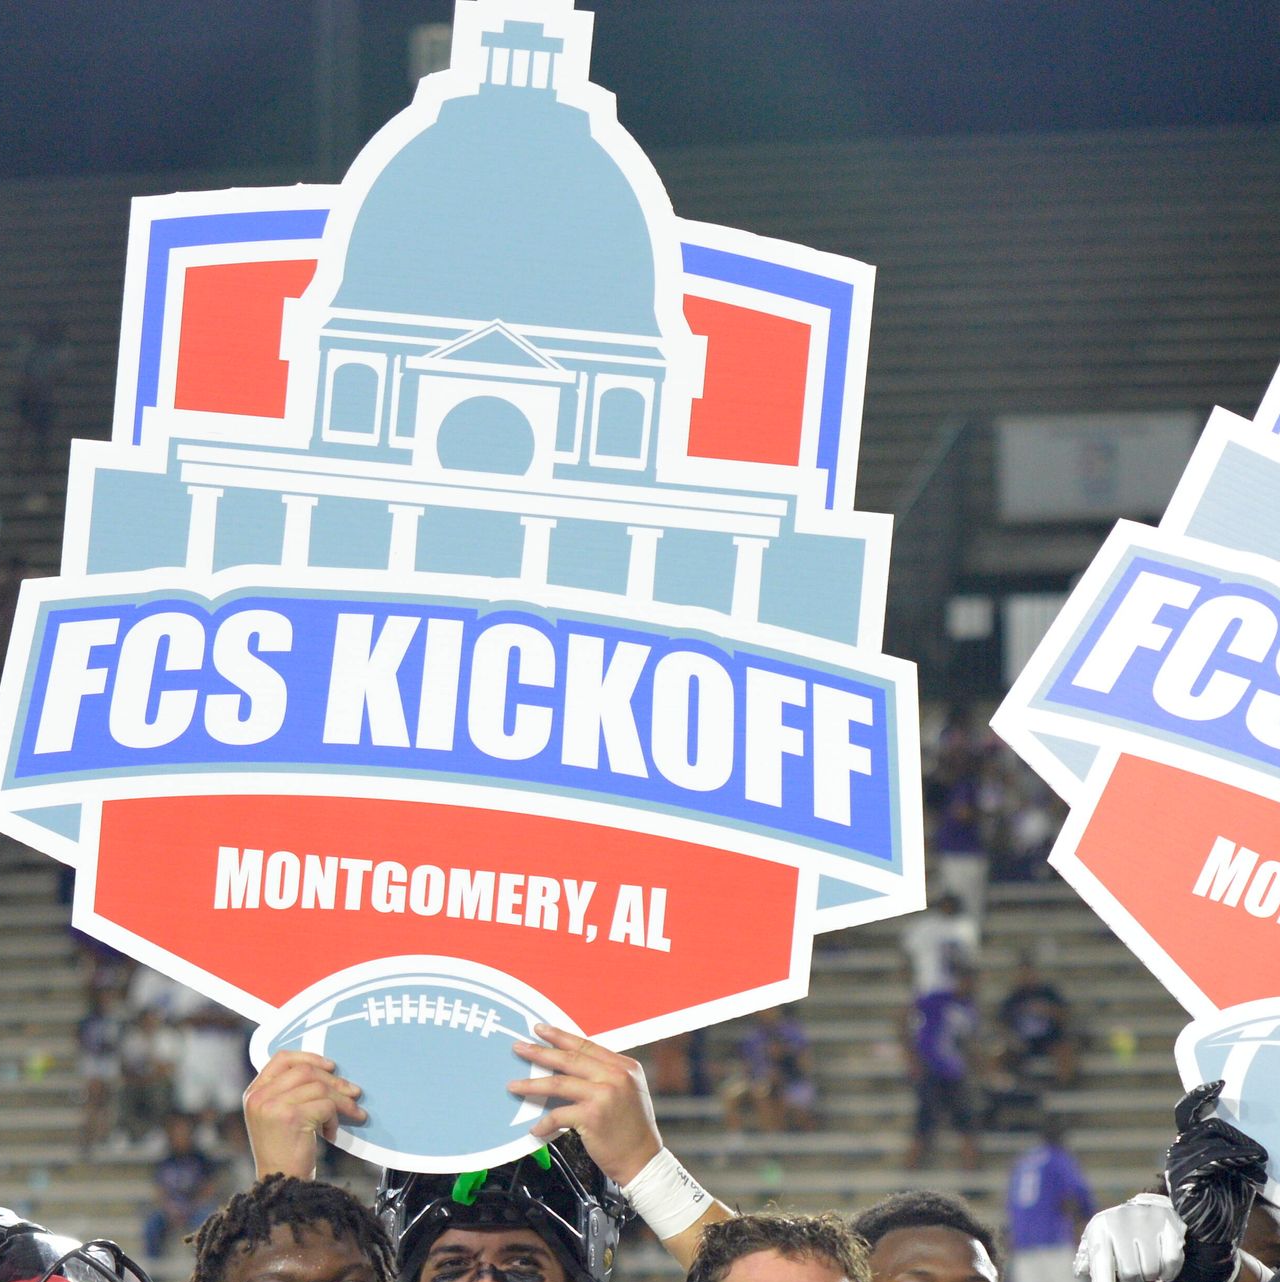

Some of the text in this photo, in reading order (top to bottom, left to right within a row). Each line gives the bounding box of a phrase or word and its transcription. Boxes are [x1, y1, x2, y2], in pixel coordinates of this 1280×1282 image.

[33, 609, 874, 827] FCS KICKOFF
[214, 847, 671, 953] MONTGOMERY, AL
